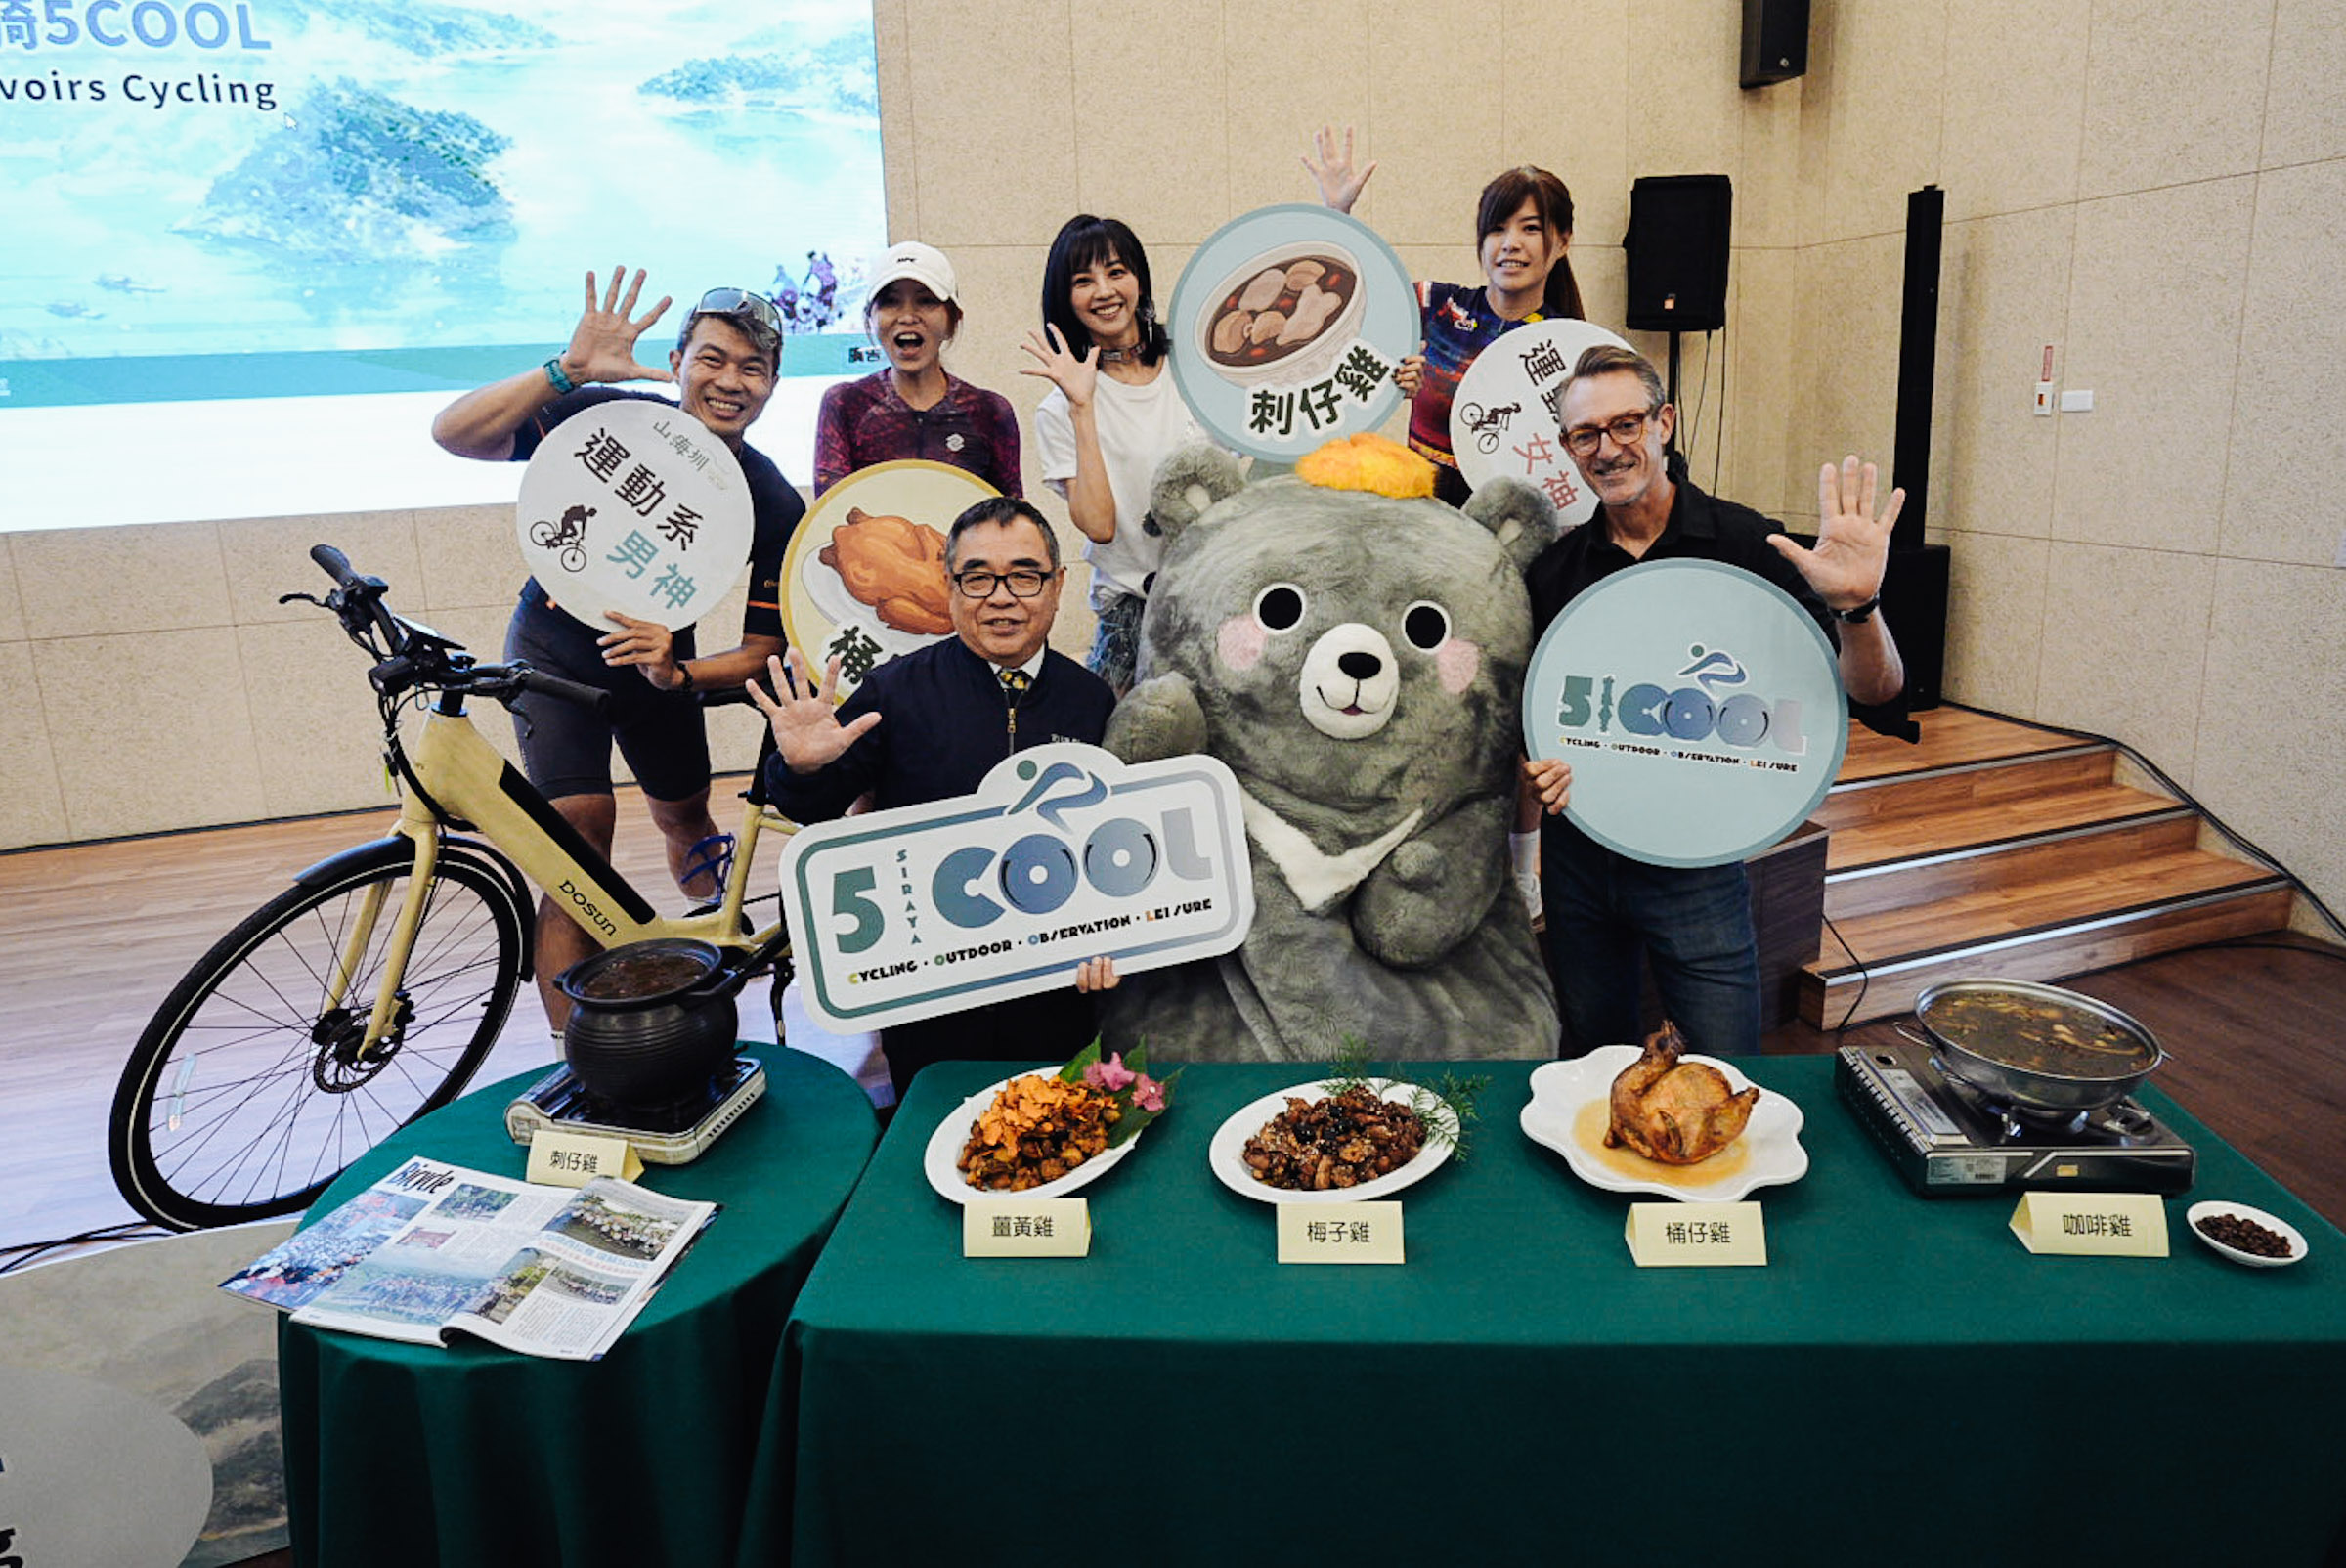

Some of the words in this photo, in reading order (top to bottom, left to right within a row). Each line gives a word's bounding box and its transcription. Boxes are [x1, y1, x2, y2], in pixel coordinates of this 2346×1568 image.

[0, 70, 106, 101] voirs
[122, 74, 277, 110] Cycling
[574, 427, 704, 551] 運動系
[1512, 432, 1579, 510] 女神
[606, 529, 697, 609] 男神
[1559, 675, 1593, 727] 5
[1618, 683, 1806, 755] COOL
[832, 866, 885, 954] 5
[932, 807, 1213, 929] COOL
[896, 849, 922, 945] SIRAYA
[848, 960, 918, 984] CYCLING
[934, 939, 1013, 966] OUTDOOR
[1028, 915, 1131, 945] OBSERVATION
[1145, 898, 1212, 922] LEISURE
[388, 1162, 454, 1194] Bicycle
[549, 1150, 598, 1173] 刺仔雞
[991, 1215, 1054, 1237] 薑黃雞
[1306, 1221, 1370, 1242] 梅子雞
[1665, 1222, 1731, 1244] 桶仔雞
[2063, 1214, 2132, 1237] 咖啡雞
